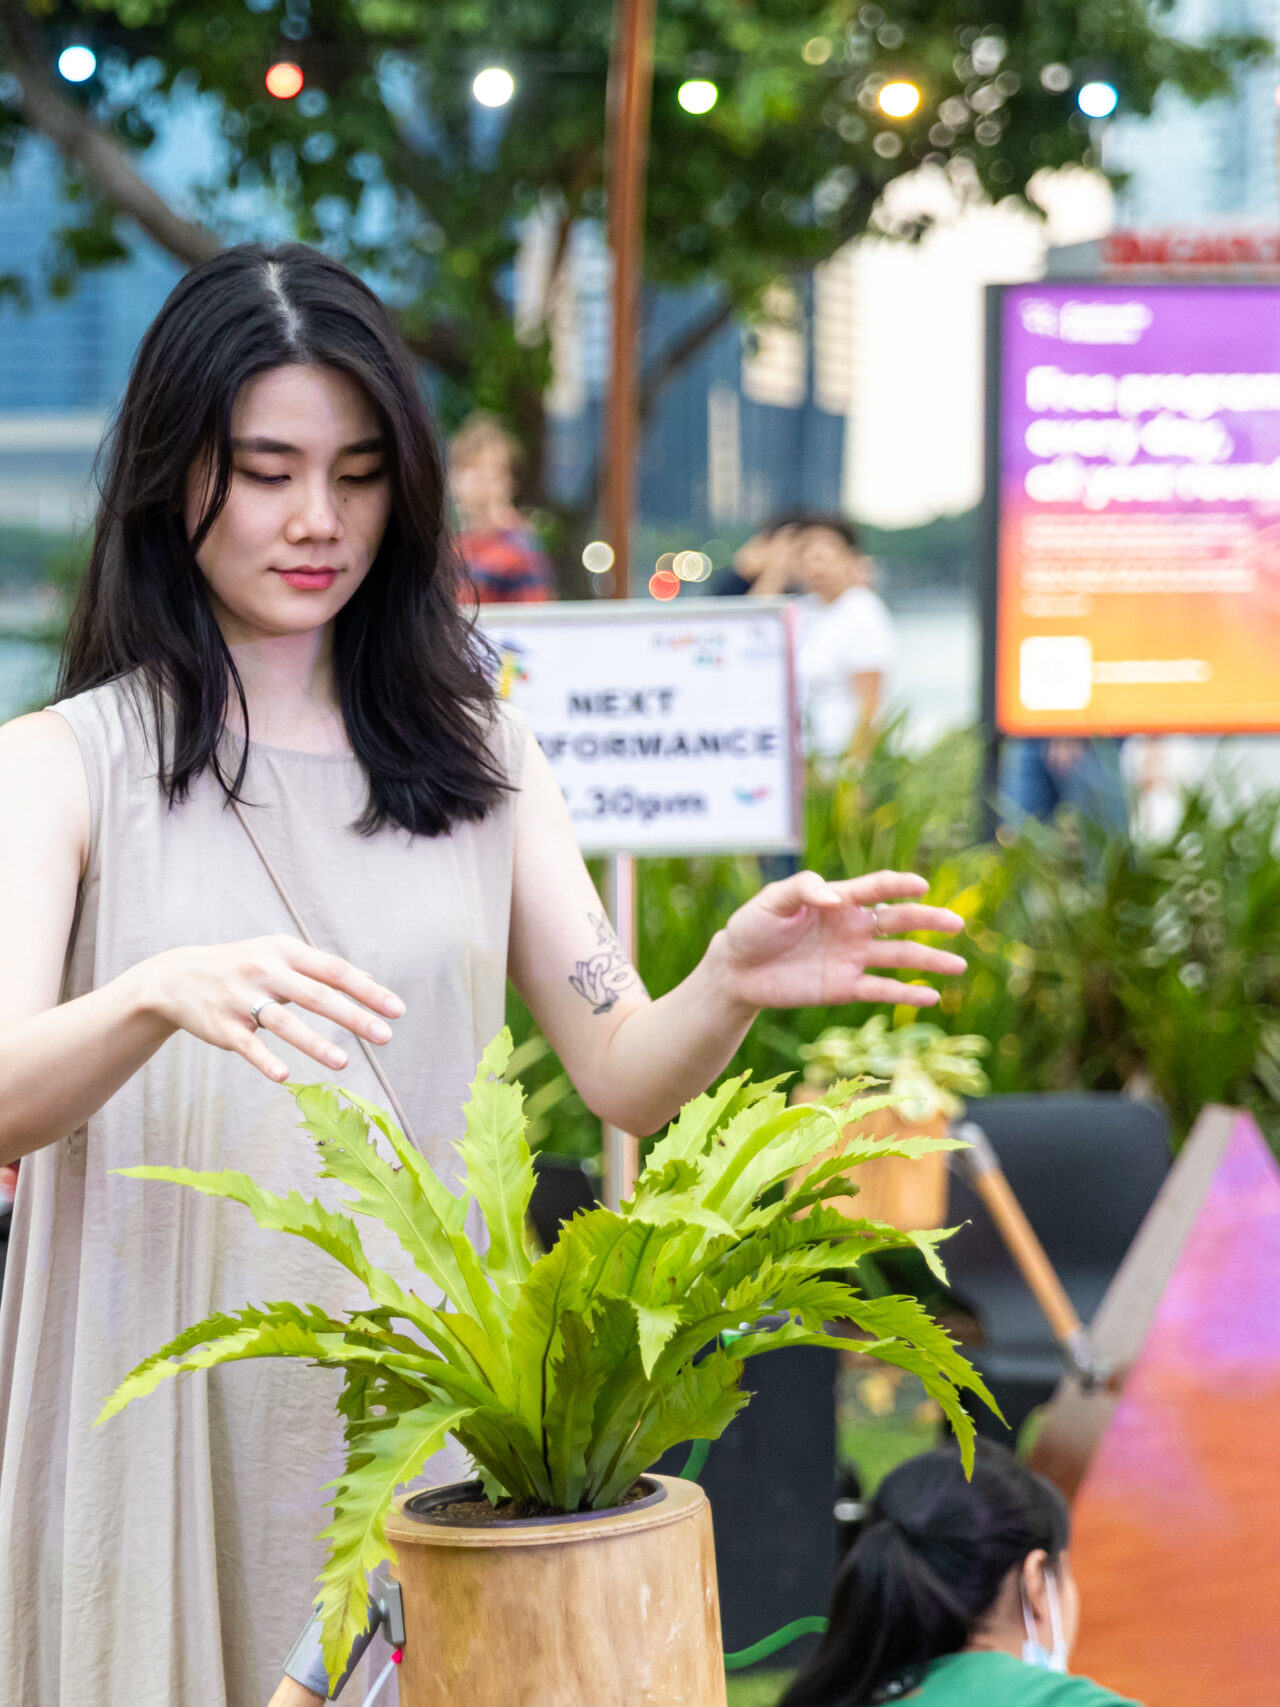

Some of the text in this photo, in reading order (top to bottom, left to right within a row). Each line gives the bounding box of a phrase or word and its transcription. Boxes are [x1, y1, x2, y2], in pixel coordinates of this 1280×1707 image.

[568, 686, 676, 717] NEXT
[530, 730, 780, 762] FORMANCE
[562, 785, 708, 823] .30pm
